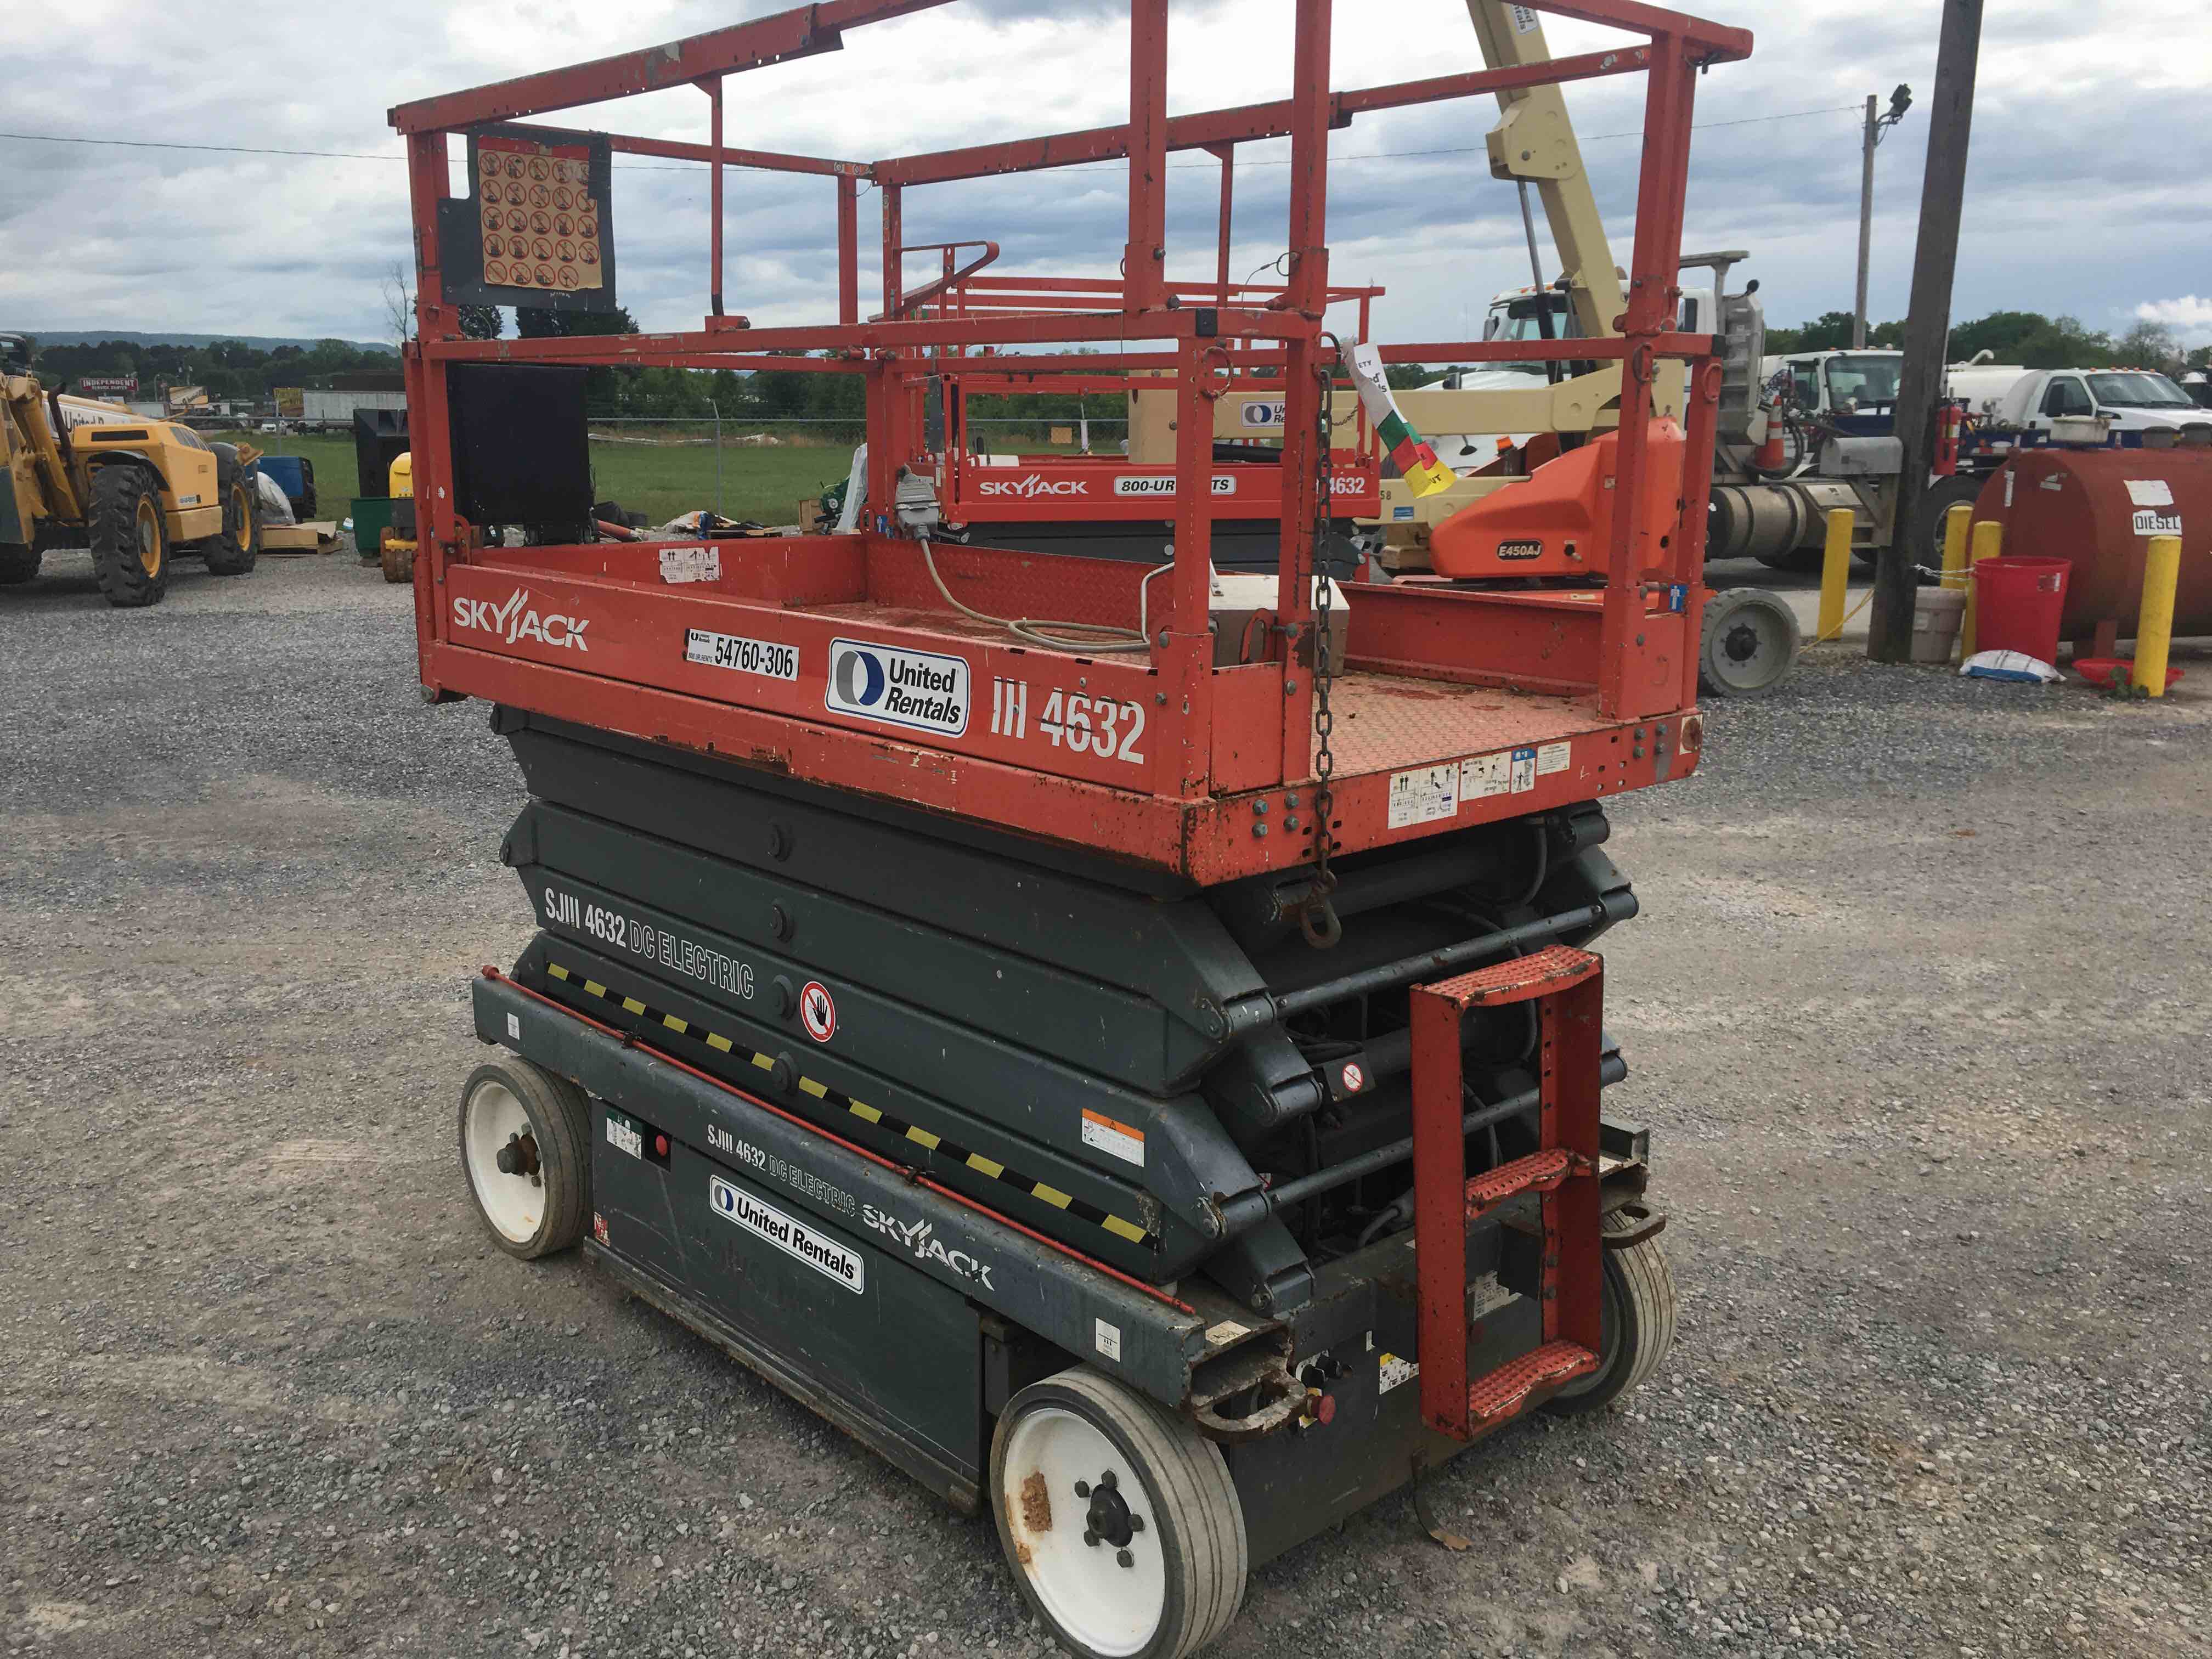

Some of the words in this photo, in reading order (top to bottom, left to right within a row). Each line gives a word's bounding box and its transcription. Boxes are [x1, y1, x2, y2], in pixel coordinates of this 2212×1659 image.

[979, 473, 1089, 498] SKYJACK
[2135, 515, 2180, 529] DIESEL
[1498, 545, 1541, 556] E450AJ
[453, 588, 590, 652] SKYJACK
[714, 636, 793, 678] 54760-306
[889, 658, 956, 694] United
[884, 686, 961, 724] Rentals
[1040, 687, 1145, 765] 4632
[545, 887, 580, 929] SJIII
[585, 904, 627, 947] 4632
[630, 919, 656, 960] DC
[658, 930, 754, 1000] ELECTRIC
[707, 1124, 733, 1154] SJIII
[736, 1139, 766, 1172] 4632
[769, 1154, 787, 1182] DC
[789, 1165, 856, 1217] ELECTRIC
[737, 1197, 789, 1243] United
[792, 1228, 855, 1280] Rentals
[862, 1204, 995, 1292] SKYJACK
